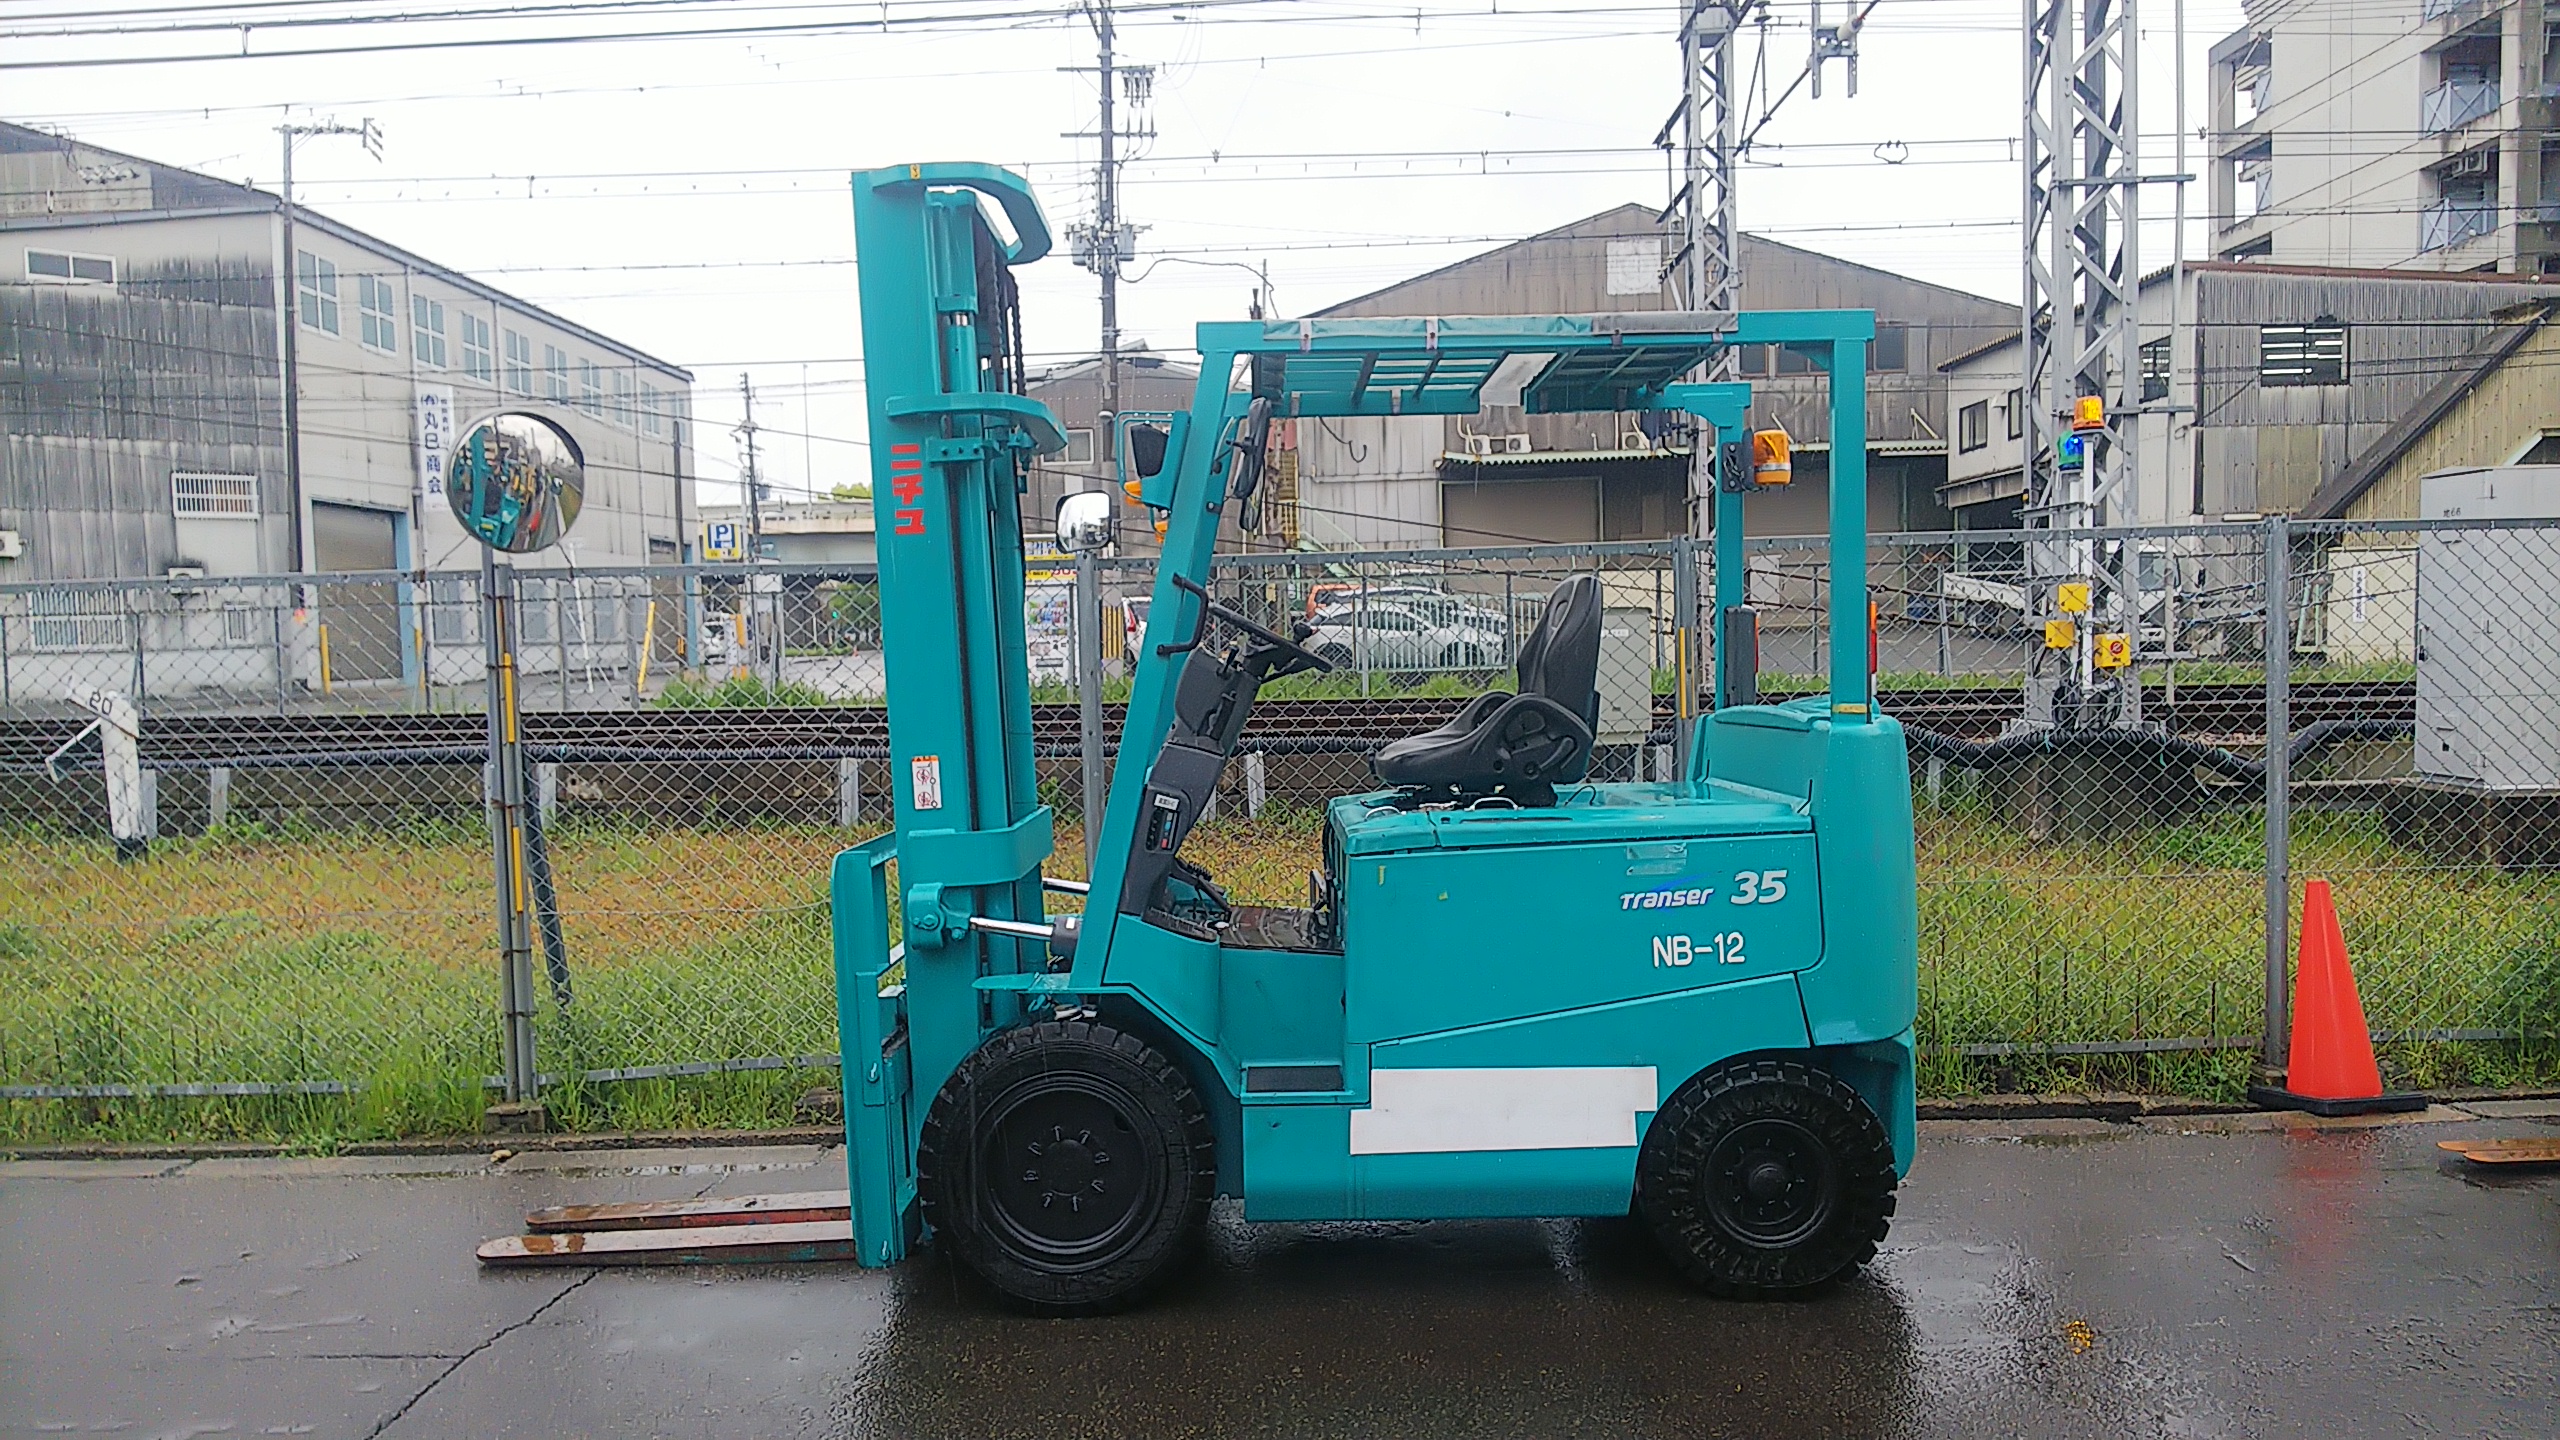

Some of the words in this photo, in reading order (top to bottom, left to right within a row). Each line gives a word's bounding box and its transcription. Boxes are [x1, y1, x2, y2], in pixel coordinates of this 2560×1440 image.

[891, 444, 926, 535] ニチユ
[715, 524, 729, 539] P
[1620, 888, 1714, 910] Transer
[1730, 870, 1788, 905] 35
[1652, 932, 1746, 968] NB-12
